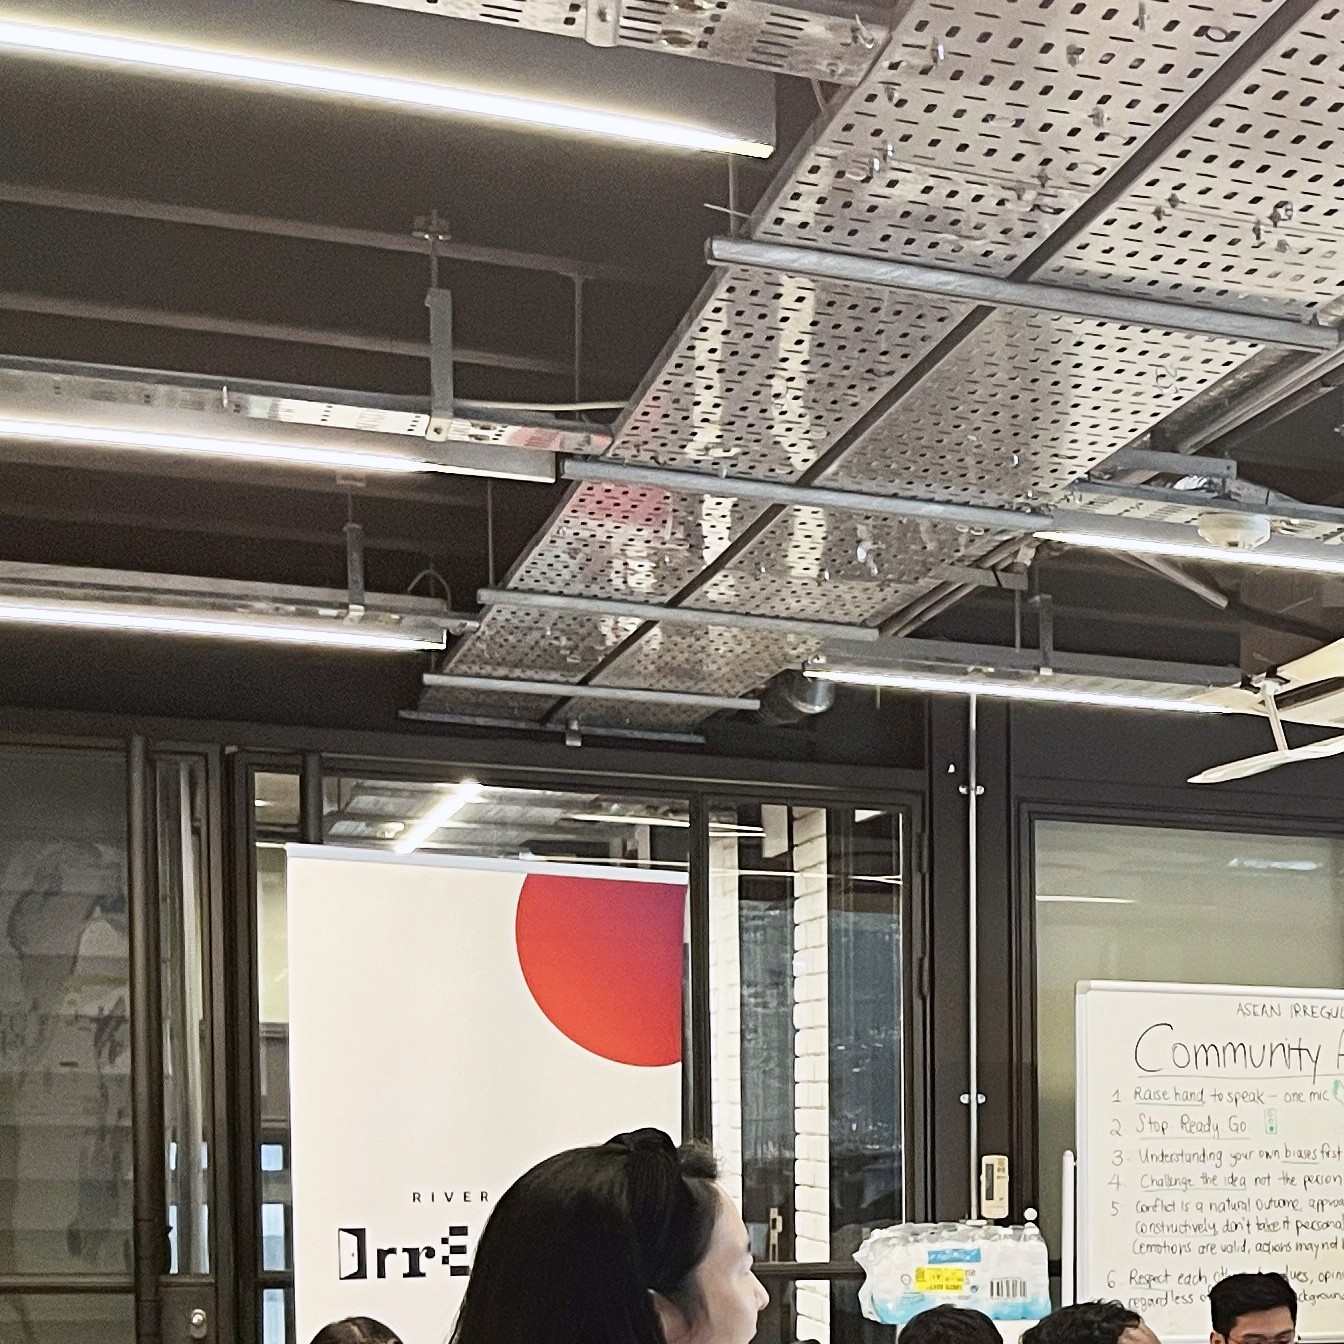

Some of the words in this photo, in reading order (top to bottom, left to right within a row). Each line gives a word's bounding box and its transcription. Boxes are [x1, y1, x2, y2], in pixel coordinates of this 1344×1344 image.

[1236, 1002, 1282, 1018] ASEAN
[1134, 1022, 1321, 1086] Community
[1173, 1087, 1204, 1103] hand
[1210, 1088, 1224, 1102] to
[1227, 1087, 1265, 1108] speak
[1284, 1092, 1304, 1103] one
[1309, 1090, 1330, 1102] mic
[1136, 1113, 1169, 1135] Stop
[1180, 1113, 1219, 1139] Ready
[1228, 1115, 1247, 1133] Go
[1138, 1147, 1223, 1168] Understanding
[1230, 1150, 1253, 1167] your
[1140, 1173, 1195, 1193] Challenge
[1200, 1172, 1218, 1186] the
[1254, 1174, 1271, 1186] not
[1278, 1172, 1297, 1186] the
[1303, 1174, 1343, 1190] person
[412, 1191, 490, 1203] RIVER
[1209, 1197, 1251, 1213] natural
[1222, 1217, 1251, 1234] don't
[1178, 1267, 1208, 1285] each
